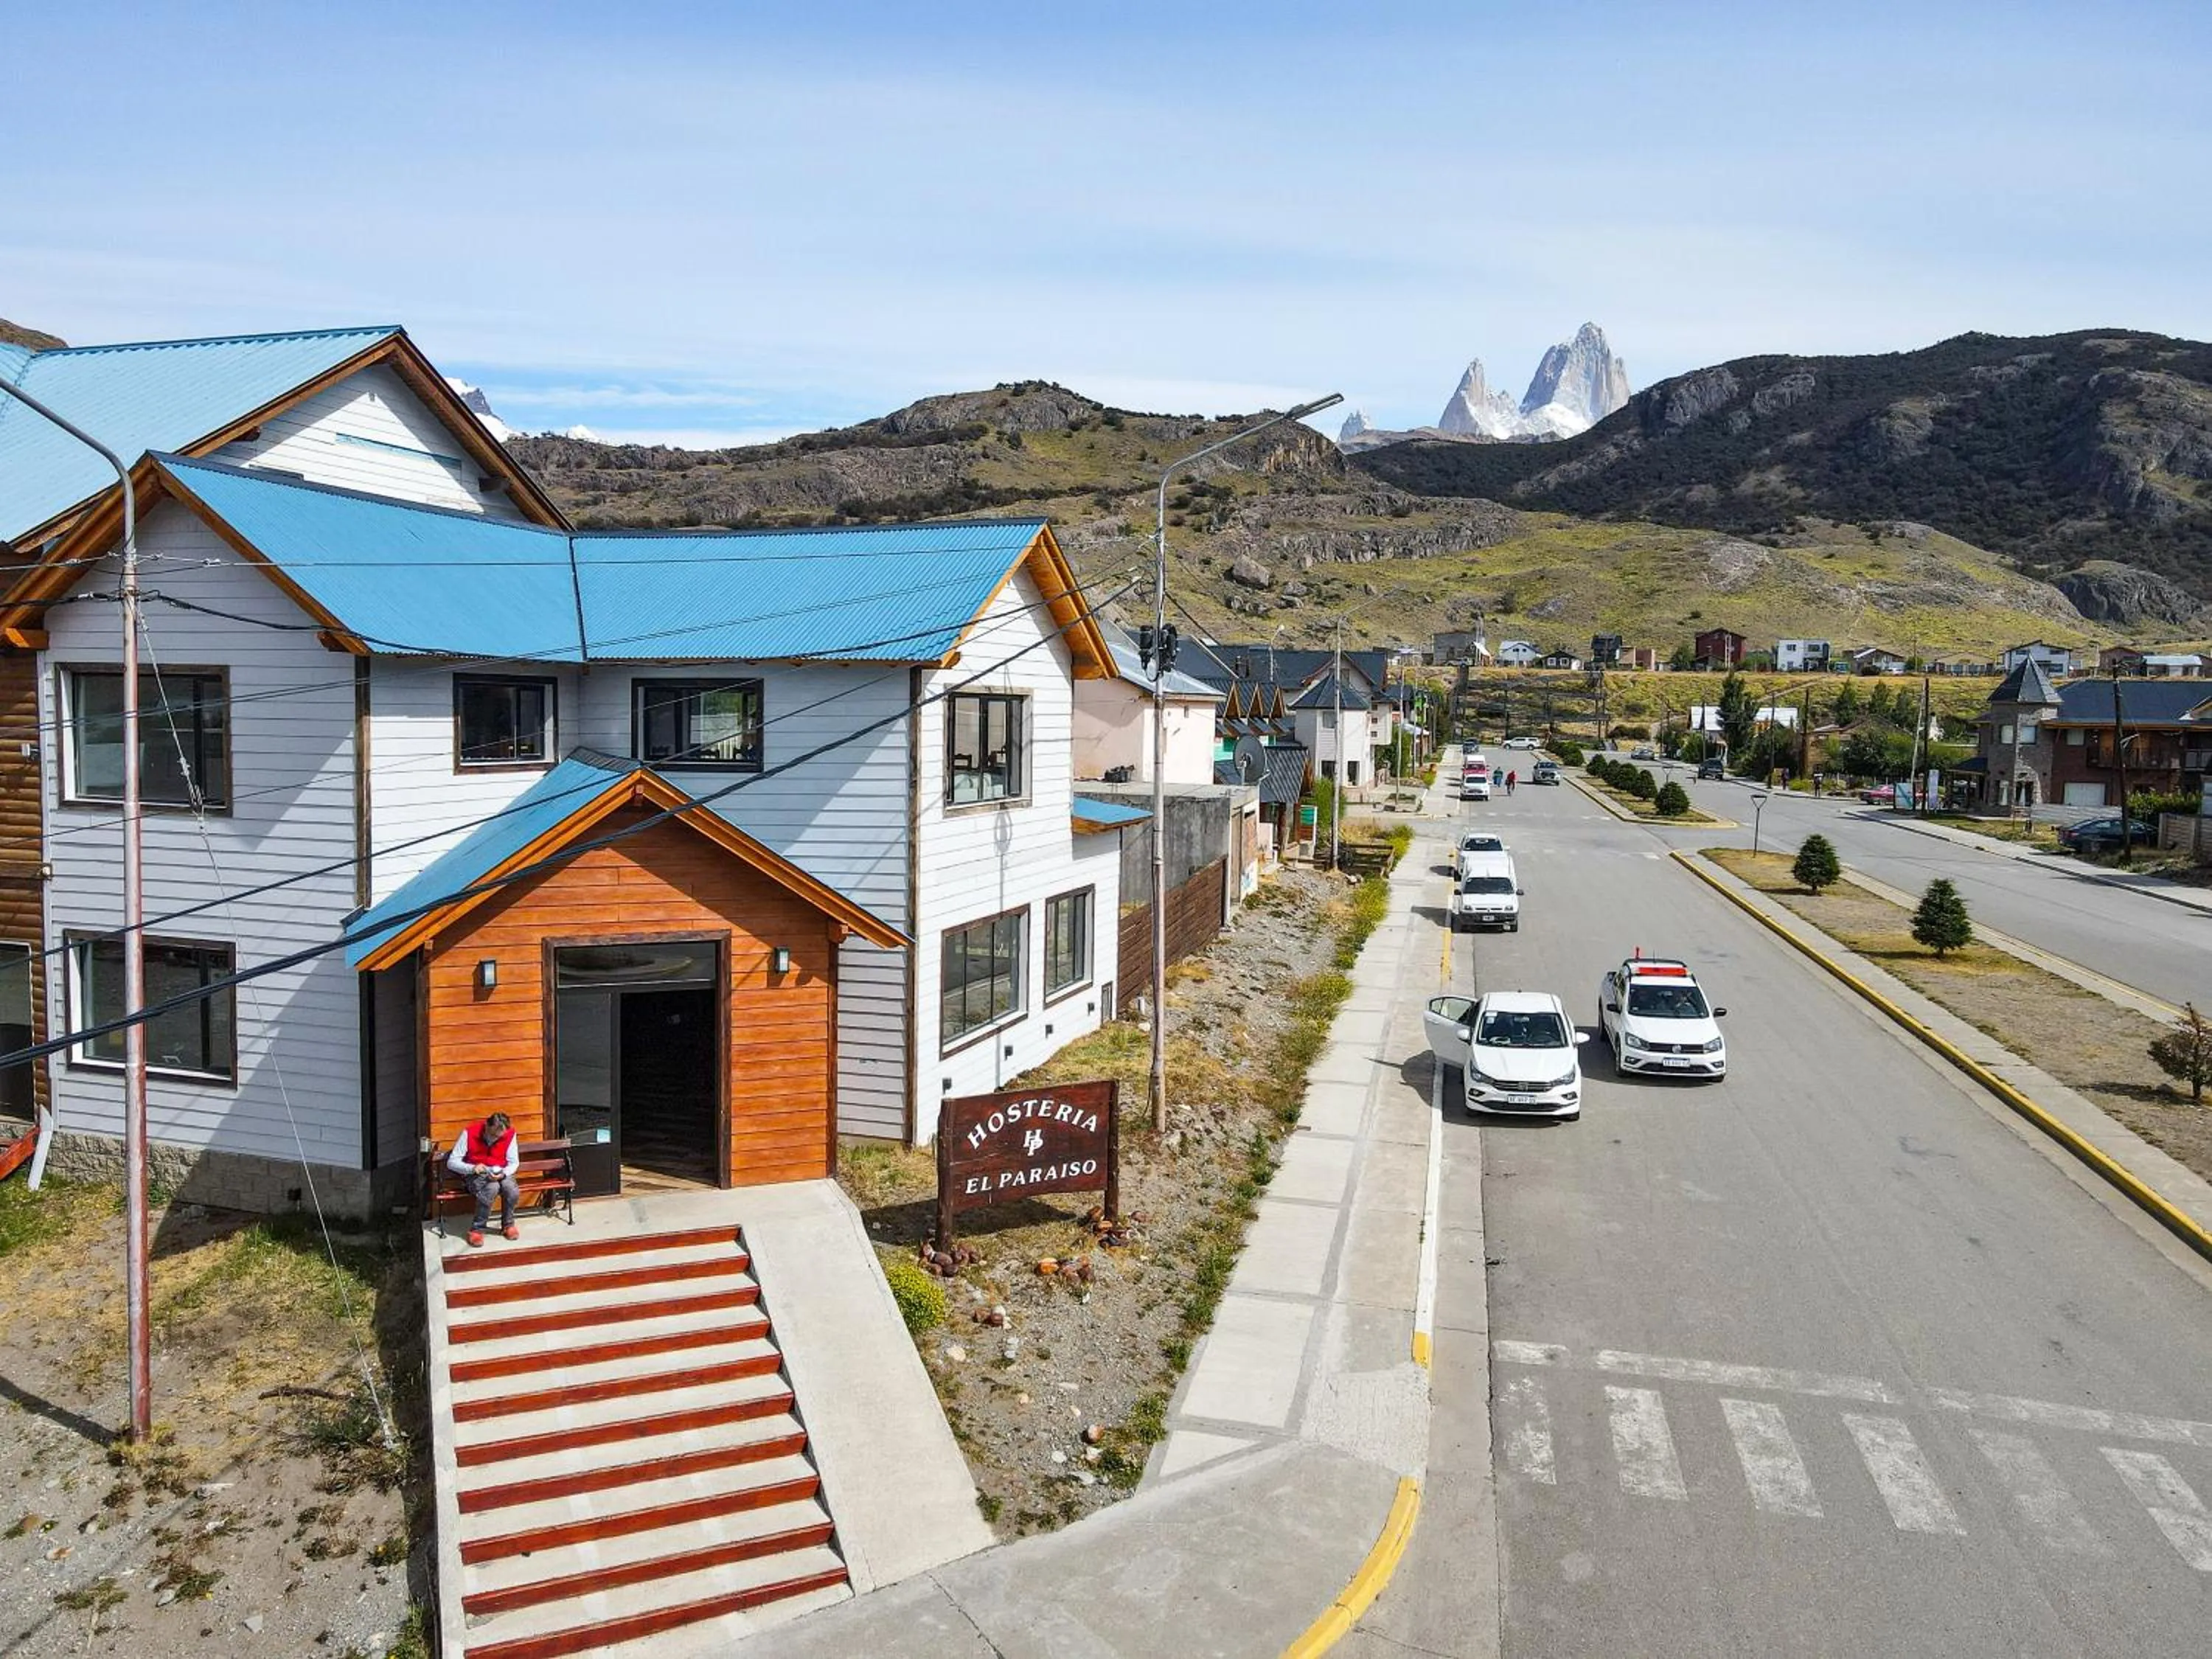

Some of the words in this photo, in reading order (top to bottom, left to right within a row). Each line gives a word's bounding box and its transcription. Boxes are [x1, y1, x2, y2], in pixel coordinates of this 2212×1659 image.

[967, 1099, 1099, 1150] HOSTERIA
[964, 1176, 992, 1194] EL
[998, 1160, 1096, 1188] PARAISO
